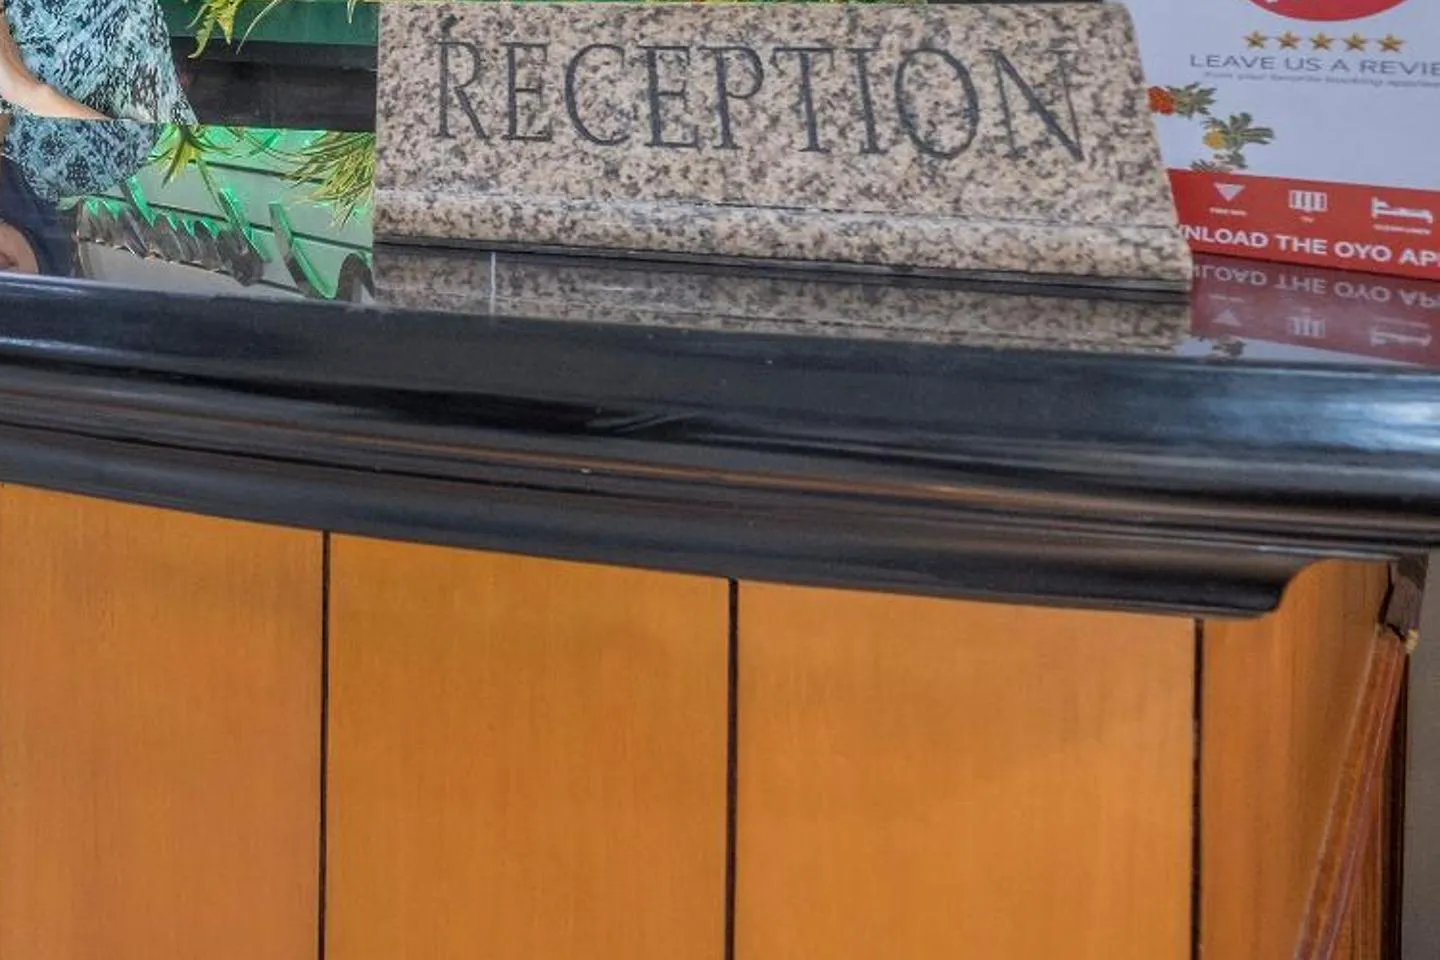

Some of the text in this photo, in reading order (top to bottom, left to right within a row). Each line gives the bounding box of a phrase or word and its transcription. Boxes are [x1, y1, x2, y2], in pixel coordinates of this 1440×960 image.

[1190, 53, 1440, 77] LEAVE US A REVIE
[433, 37, 1086, 162] RECEPTION
[1174, 224, 1440, 269] NLOAD THE OYO AP
